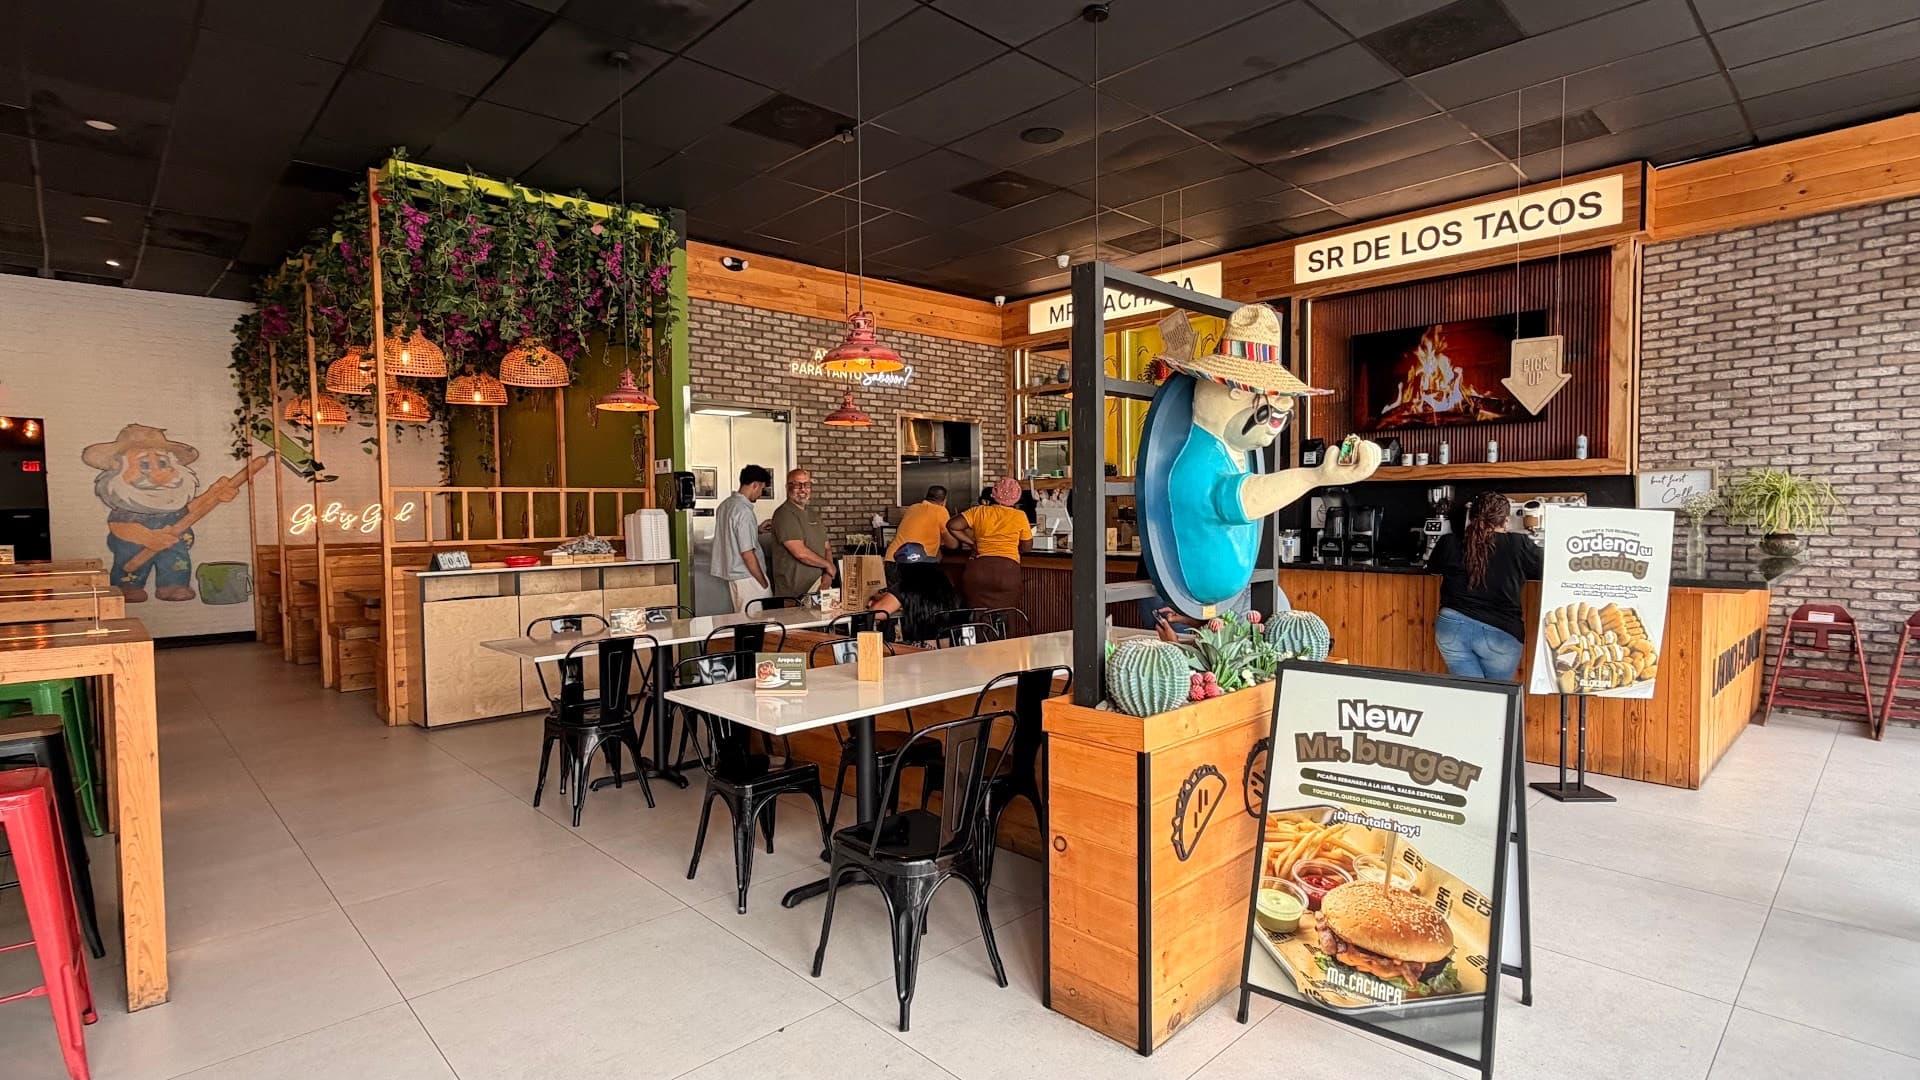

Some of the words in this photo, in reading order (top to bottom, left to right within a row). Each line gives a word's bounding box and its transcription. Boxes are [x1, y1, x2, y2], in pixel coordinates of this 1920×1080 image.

[1307, 246, 1344, 273] SR
[1353, 235, 1391, 265] DE
[1401, 220, 1463, 256] LOS
[1473, 191, 1603, 240] TACOS
[791, 363, 823, 376] PARA
[1522, 357, 1550, 372] PICK
[1527, 371, 1543, 386] UP
[360, 503, 415, 534] Gd
[1567, 533, 1640, 555] Ordena
[1640, 545, 1653, 556] tu
[1569, 553, 1649, 580] catering
[1338, 699, 1423, 737] New
[1295, 732, 1351, 762] Mr.
[1352, 732, 1483, 791] burger
[1393, 803, 1421, 814] LECHUGA
[1428, 811, 1454, 820] TOMATE
[1393, 821, 1421, 838] hoy!
